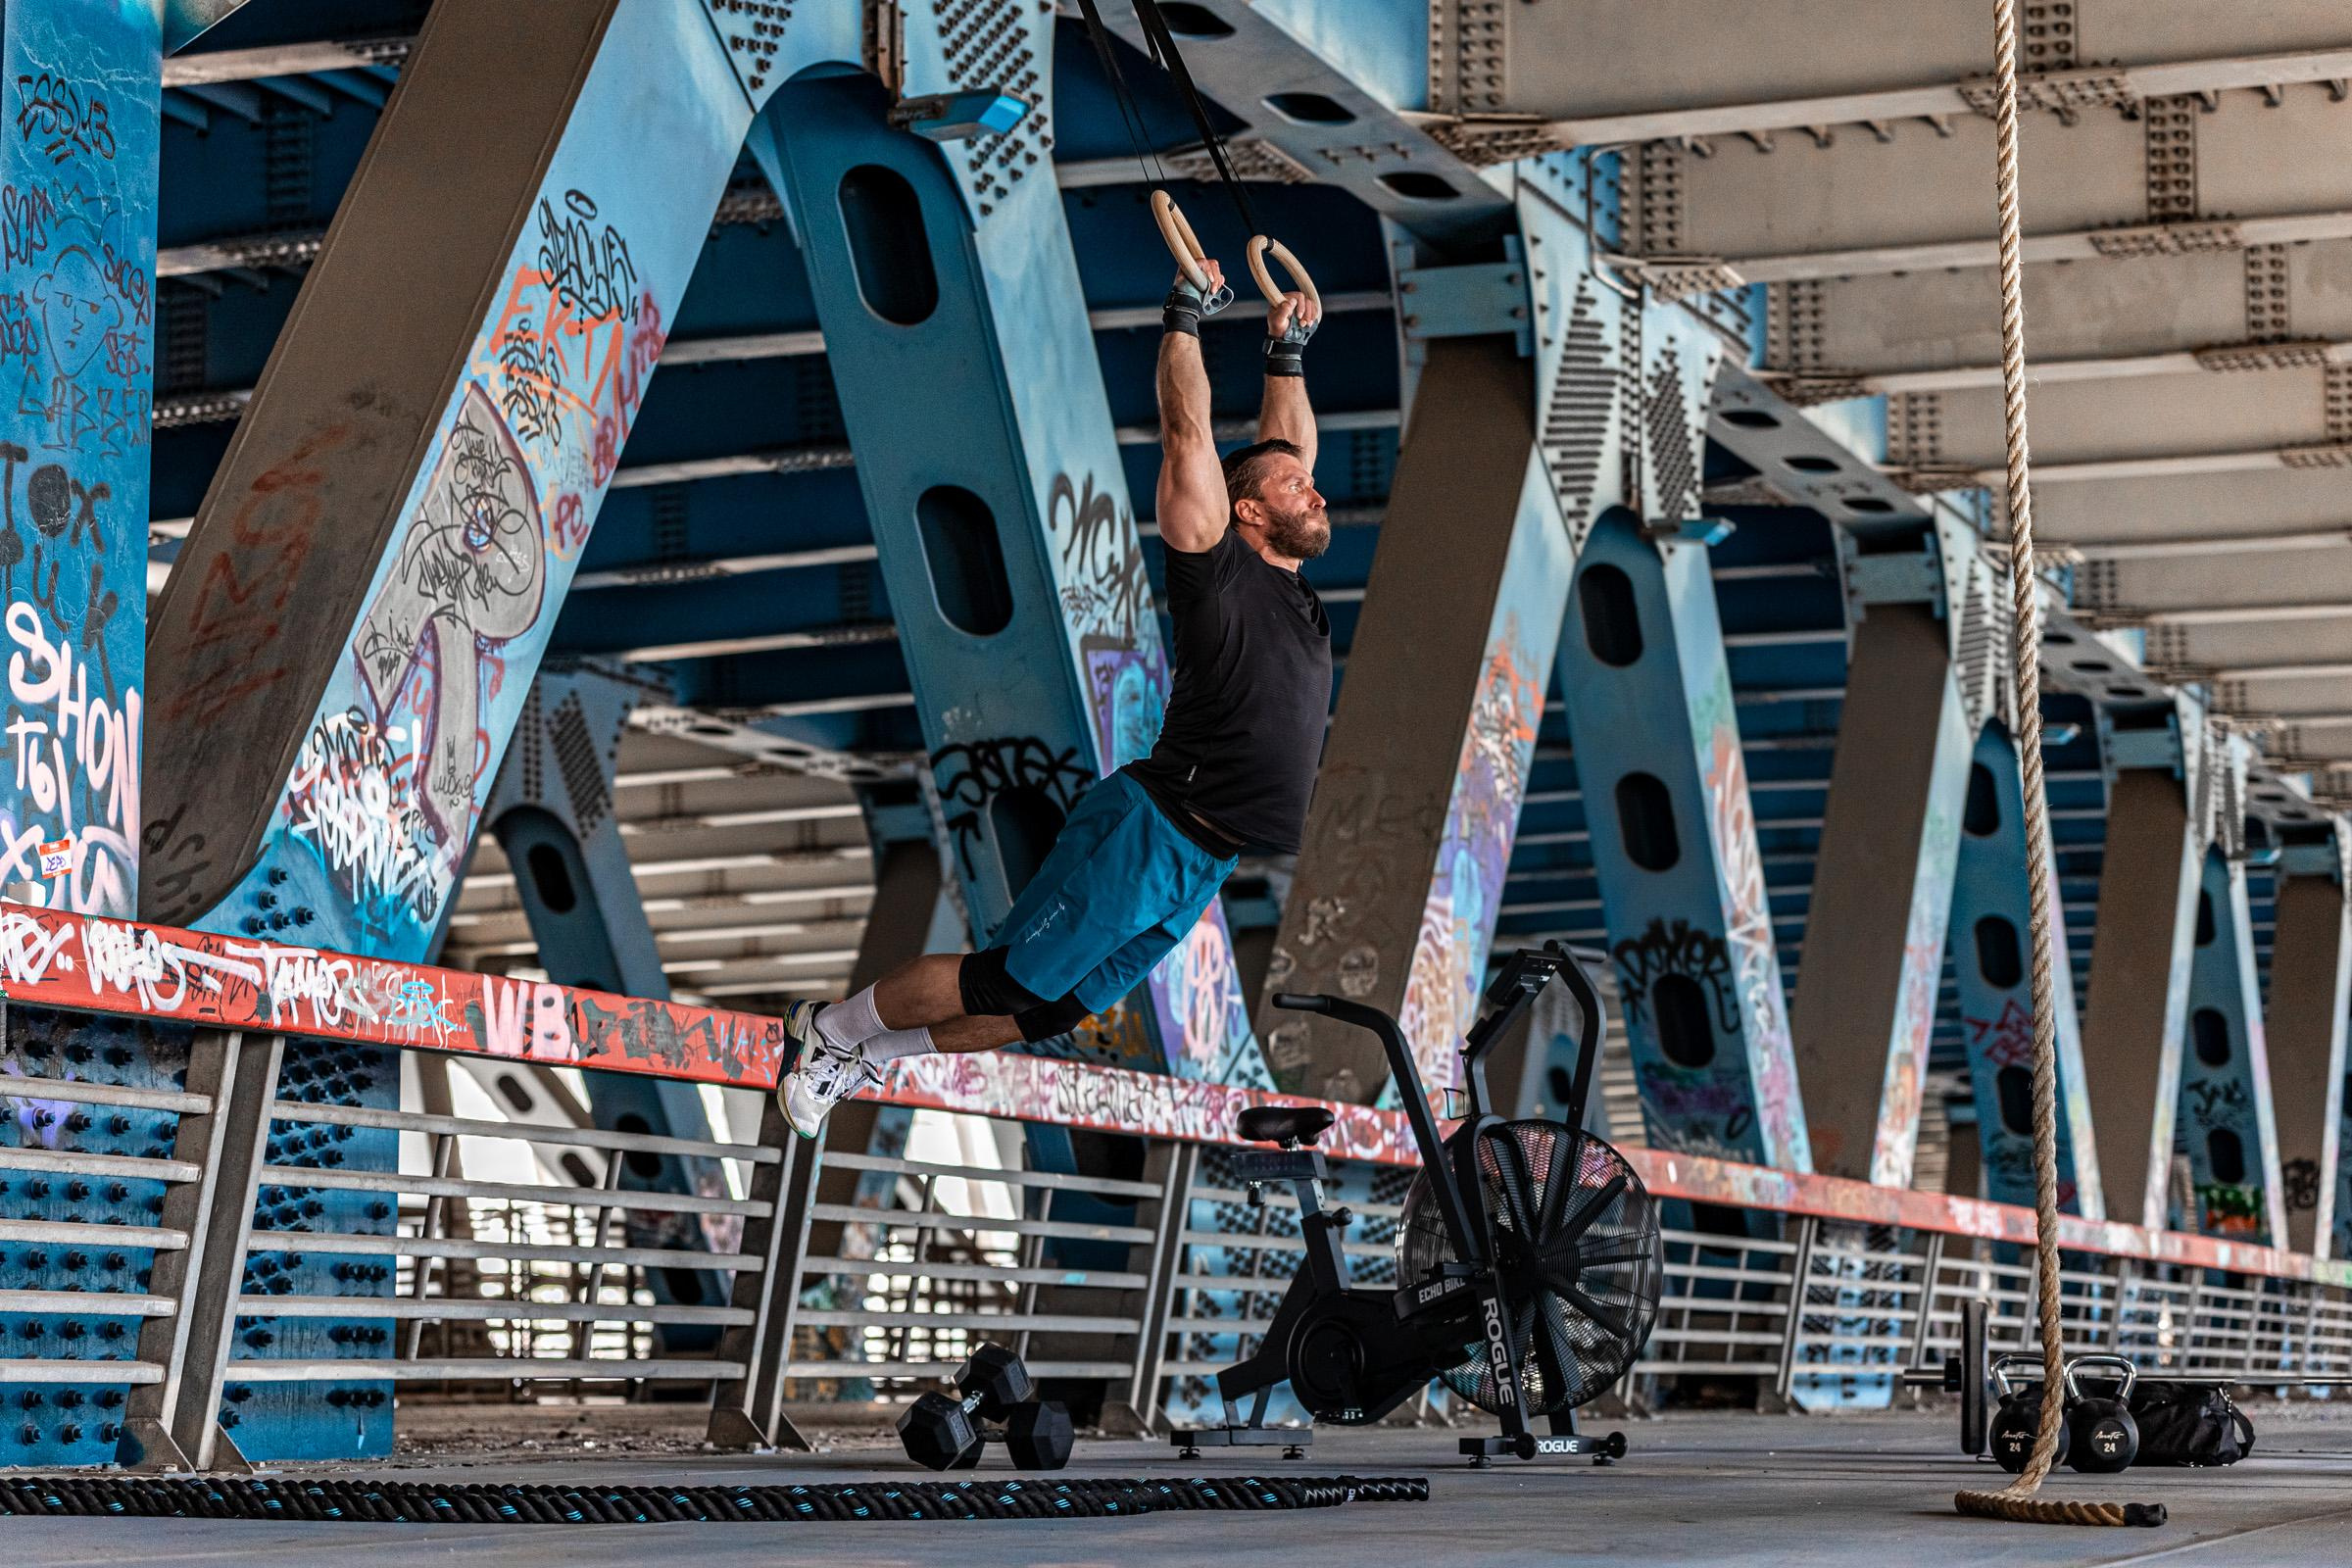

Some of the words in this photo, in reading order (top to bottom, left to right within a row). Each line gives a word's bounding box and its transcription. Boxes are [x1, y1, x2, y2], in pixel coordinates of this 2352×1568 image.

[1418, 1282, 1444, 1303] ECHO
[1482, 1297, 1515, 1405] ROGUE
[1538, 1440, 1579, 1453] ROGUE
[2009, 1443, 2022, 1452] 24
[2103, 1443, 2117, 1453] 24
